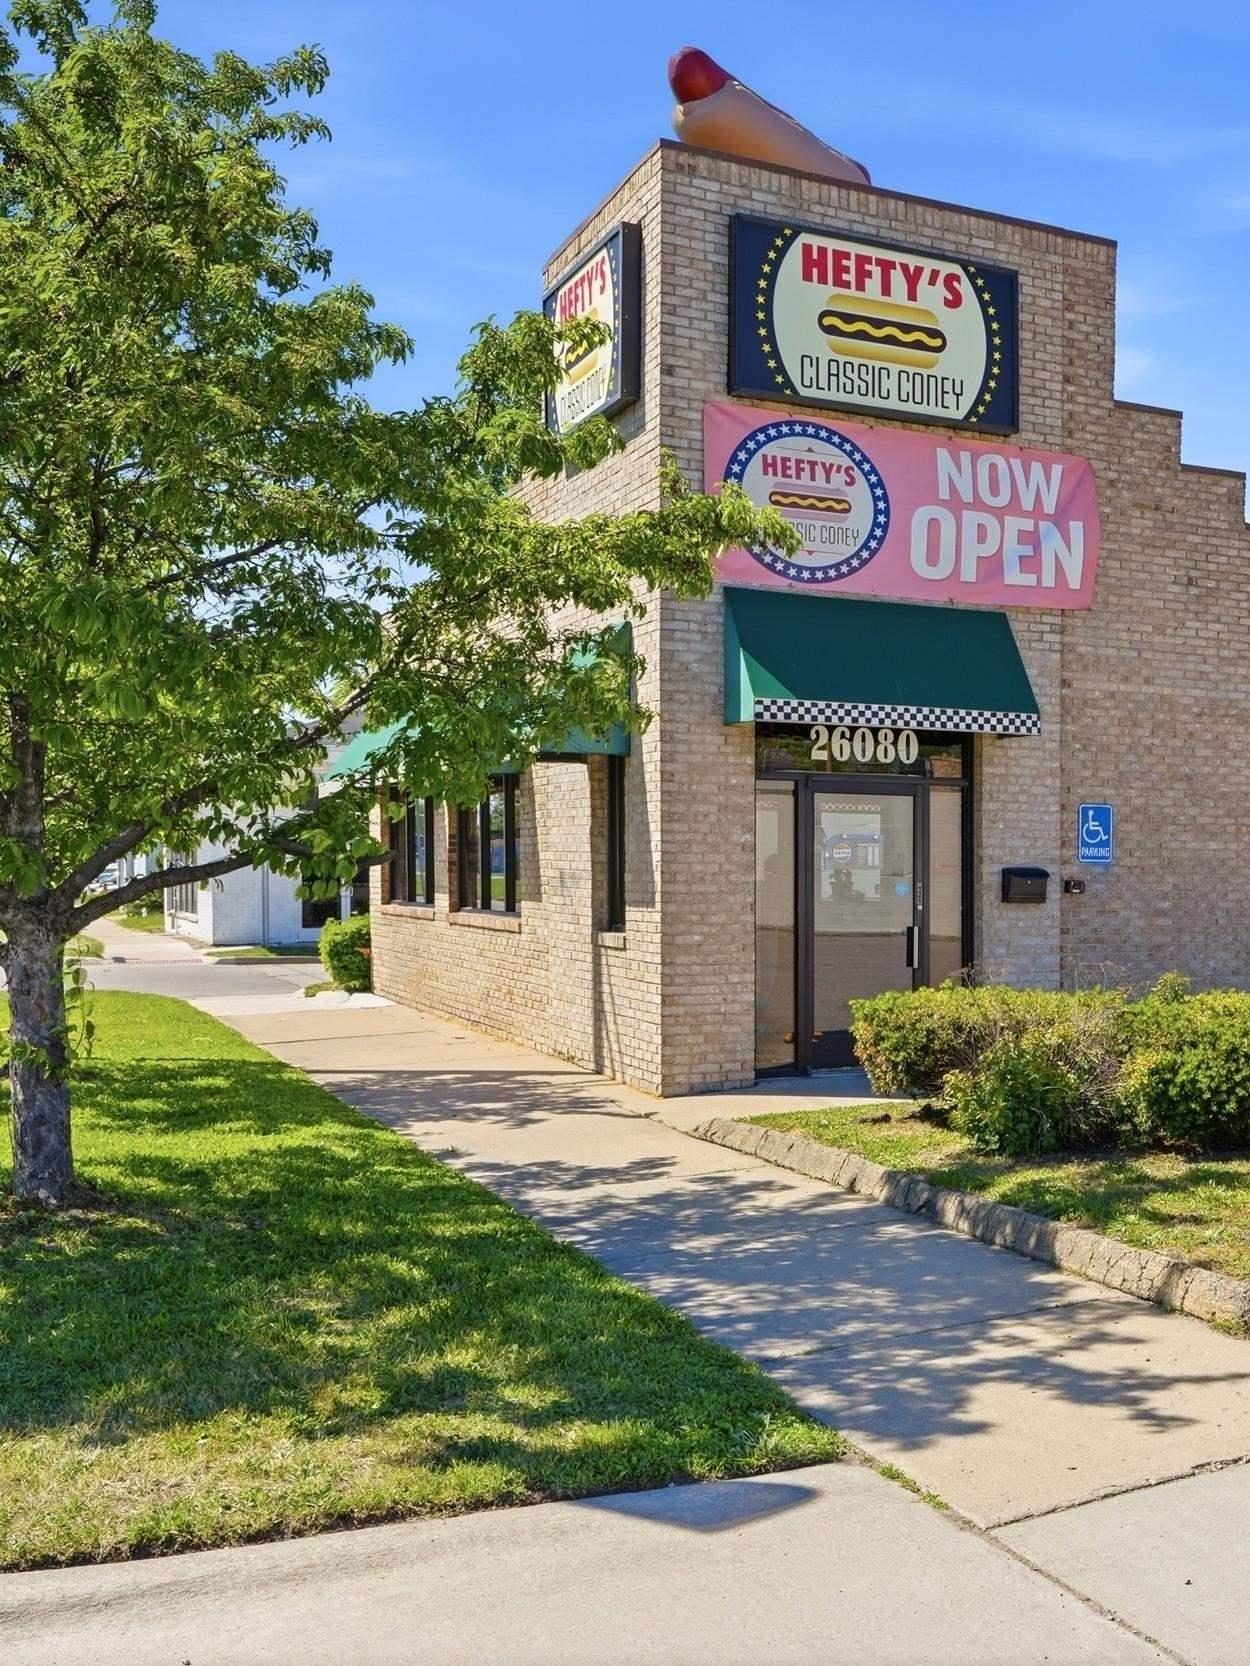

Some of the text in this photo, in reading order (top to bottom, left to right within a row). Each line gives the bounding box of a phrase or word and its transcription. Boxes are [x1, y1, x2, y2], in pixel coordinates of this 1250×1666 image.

[559, 255, 606, 324] HEFTY'S
[801, 242, 964, 310] HEFTY'S
[800, 354, 964, 412] CLASSIC CONEY
[761, 453, 857, 488] HEFTY'S
[935, 447, 1063, 515] NOW
[820, 525, 860, 547] CONEY
[910, 504, 1084, 591] OPEN
[810, 724, 919, 765] 26080
[1081, 847, 1110, 857] PARKING
